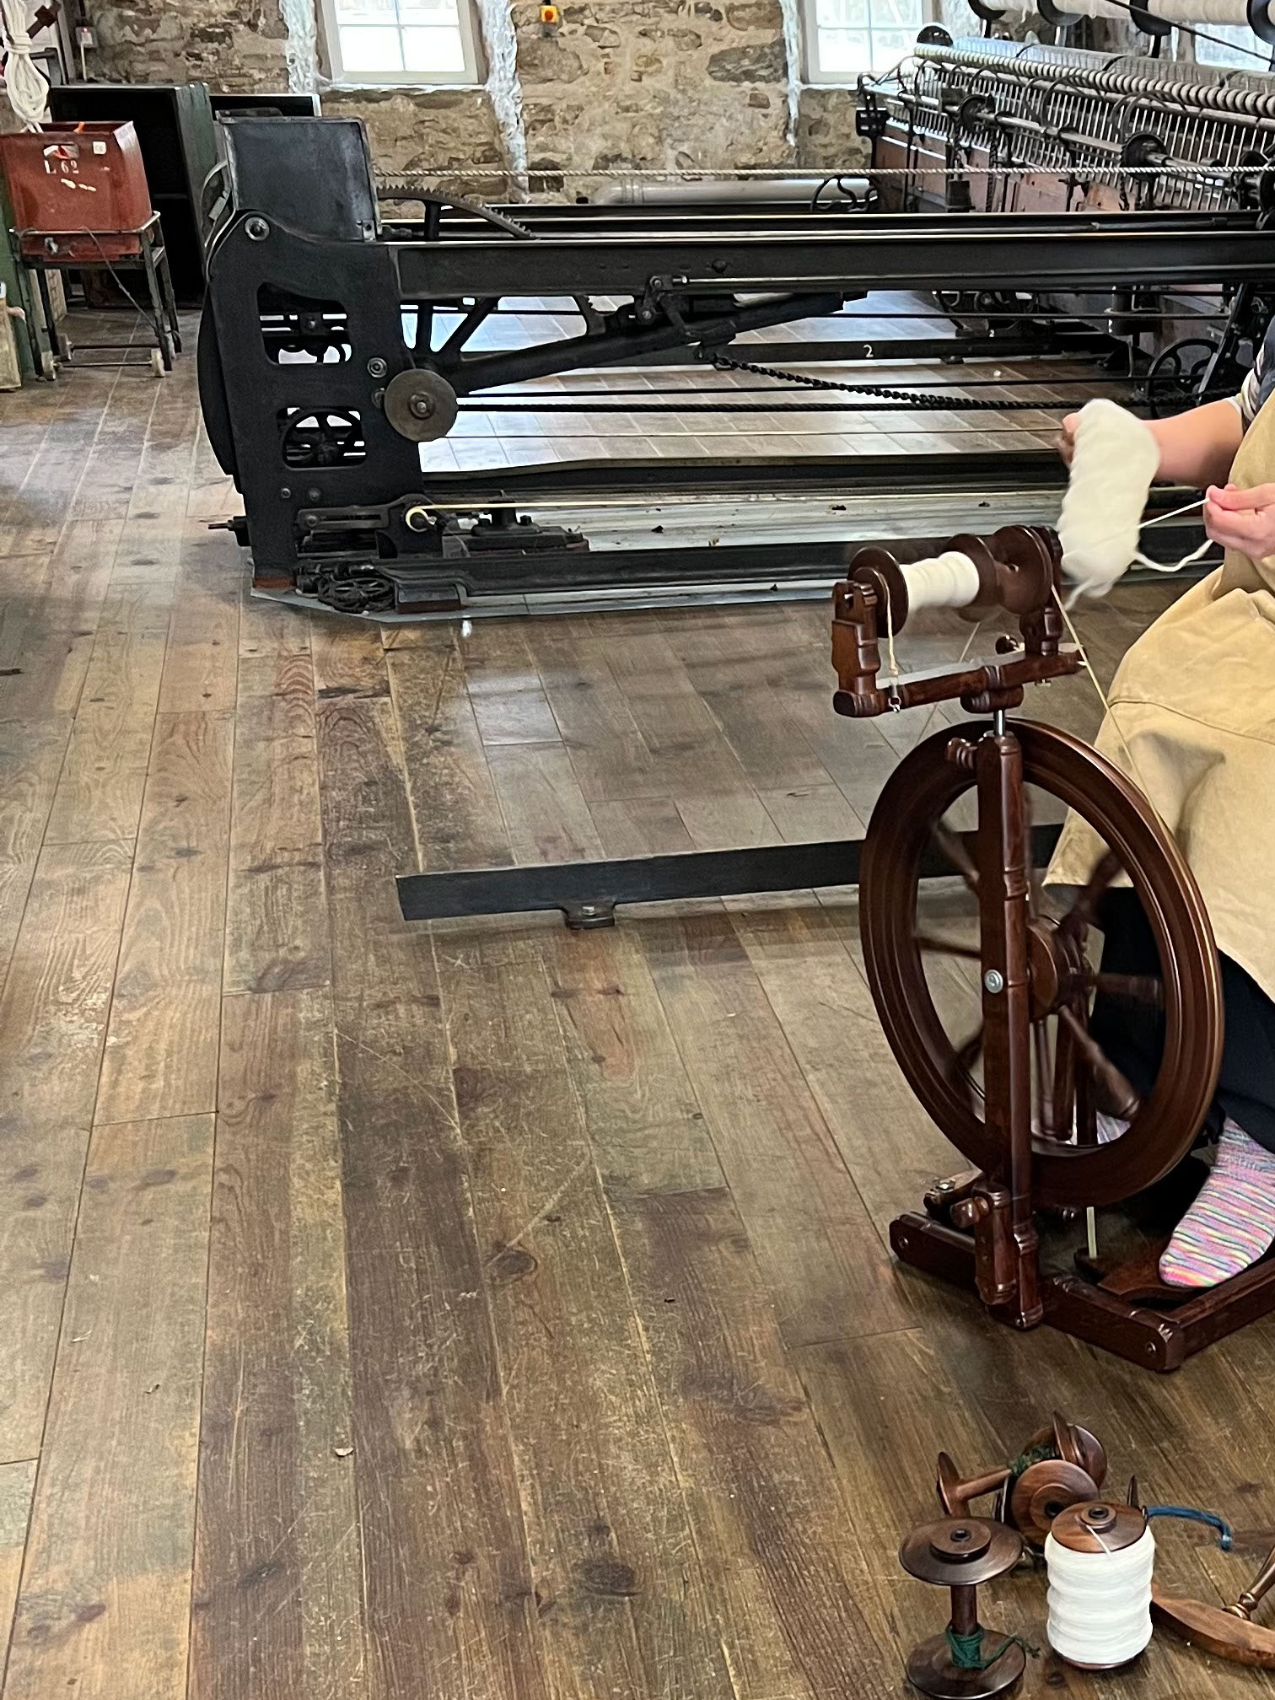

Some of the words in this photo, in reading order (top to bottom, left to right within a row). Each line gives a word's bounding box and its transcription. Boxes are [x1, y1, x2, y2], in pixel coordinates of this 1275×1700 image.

[43, 159, 57, 174] L
[60, 159, 80, 174] 62
[863, 344, 874, 358] 2
